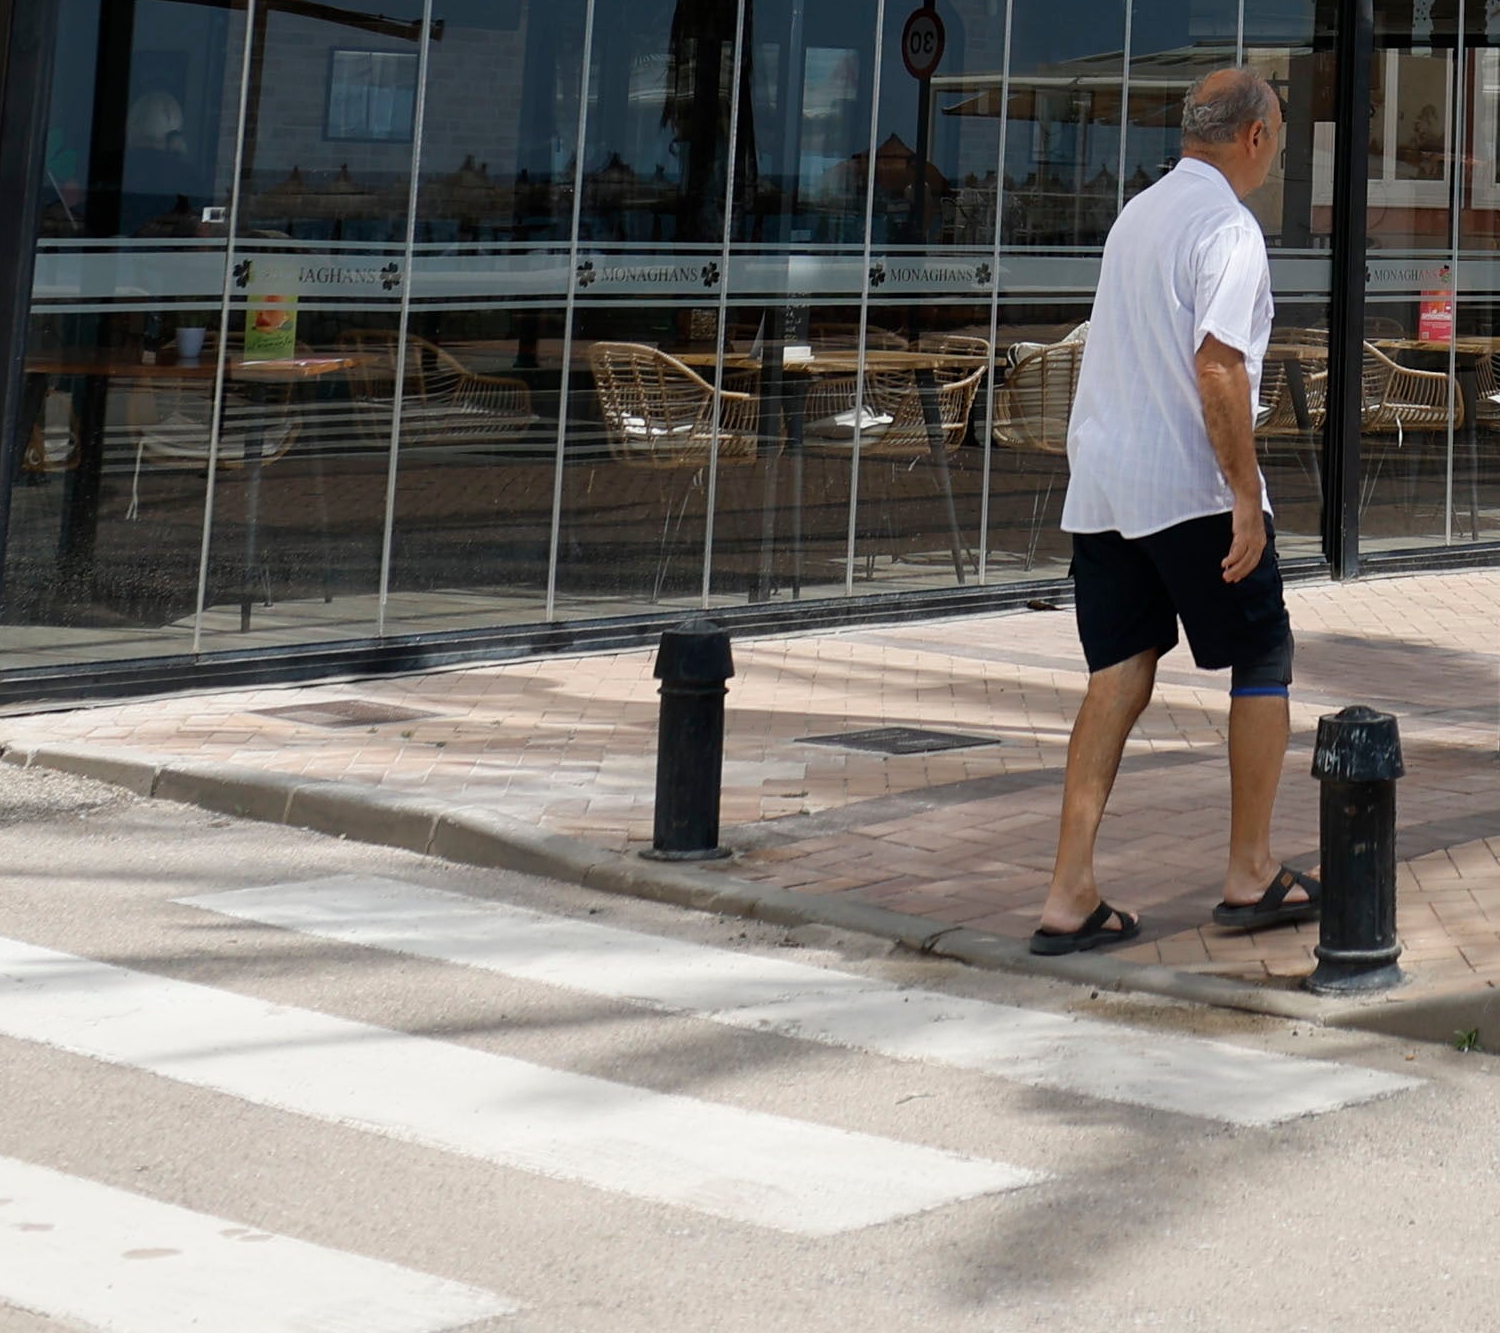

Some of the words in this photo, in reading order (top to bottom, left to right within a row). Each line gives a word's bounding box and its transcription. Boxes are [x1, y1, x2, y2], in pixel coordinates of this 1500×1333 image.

[601, 266, 699, 283] MONAGHANS
[891, 267, 974, 283] MONAGHANS
[1374, 268, 1438, 282] MONAGHANS
